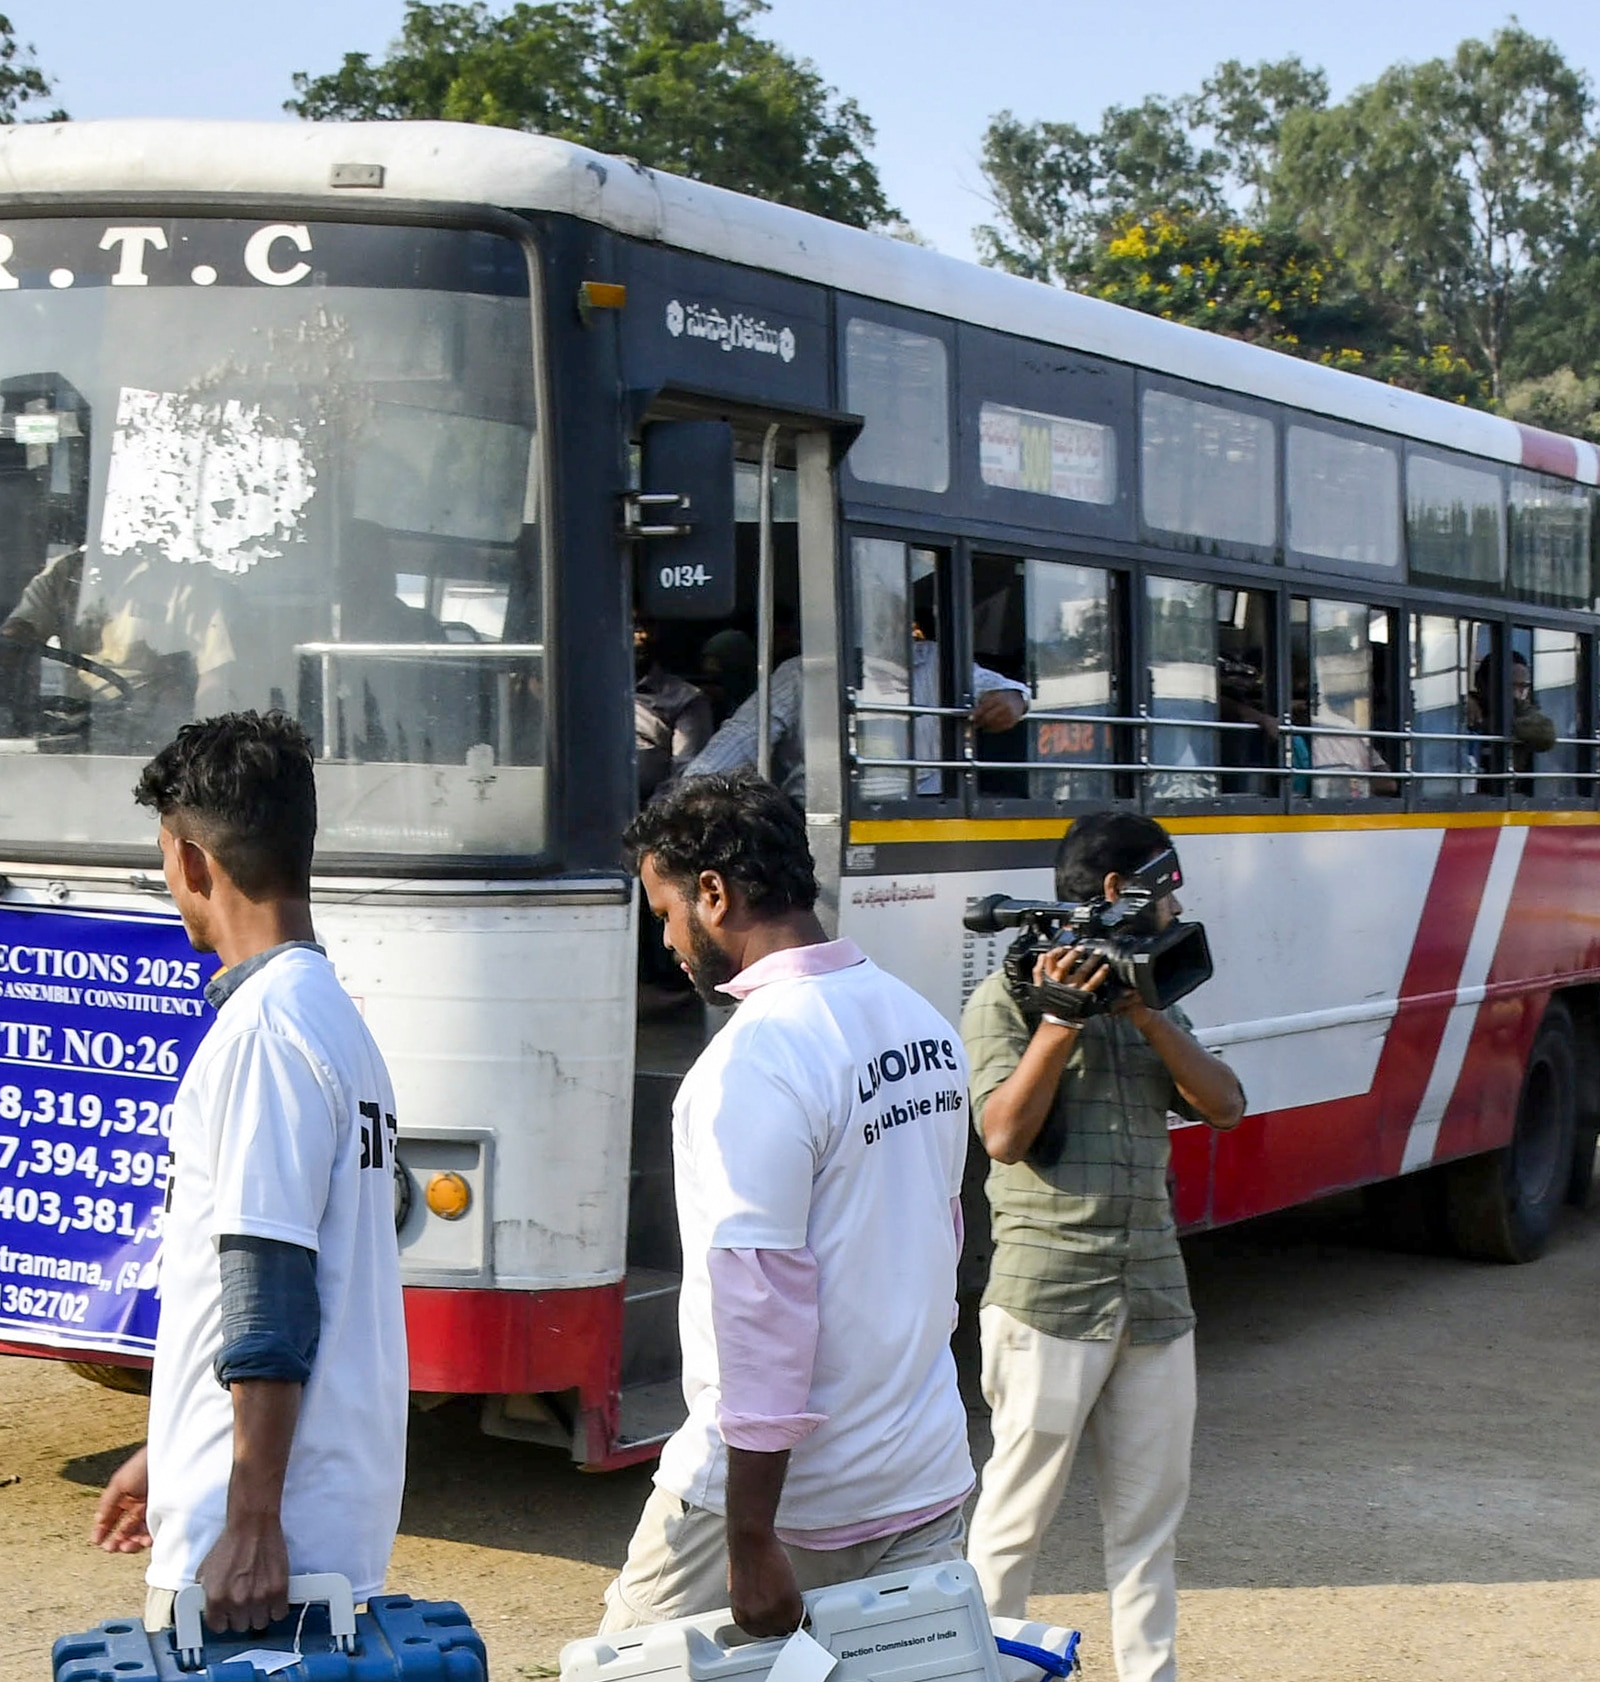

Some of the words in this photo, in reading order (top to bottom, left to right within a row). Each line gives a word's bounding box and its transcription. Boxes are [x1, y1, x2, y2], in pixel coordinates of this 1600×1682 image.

[135, 958, 201, 989] 2025
[3, 980, 83, 1005] ASSEMBLY
[84, 988, 205, 1017] CONSTITUENCY
[63, 1028, 180, 1076] NO:26
[841, 1648, 874, 1660] Election
[875, 1637, 925, 1653] Commission
[927, 1631, 936, 1642] of
[937, 1629, 958, 1640] India
